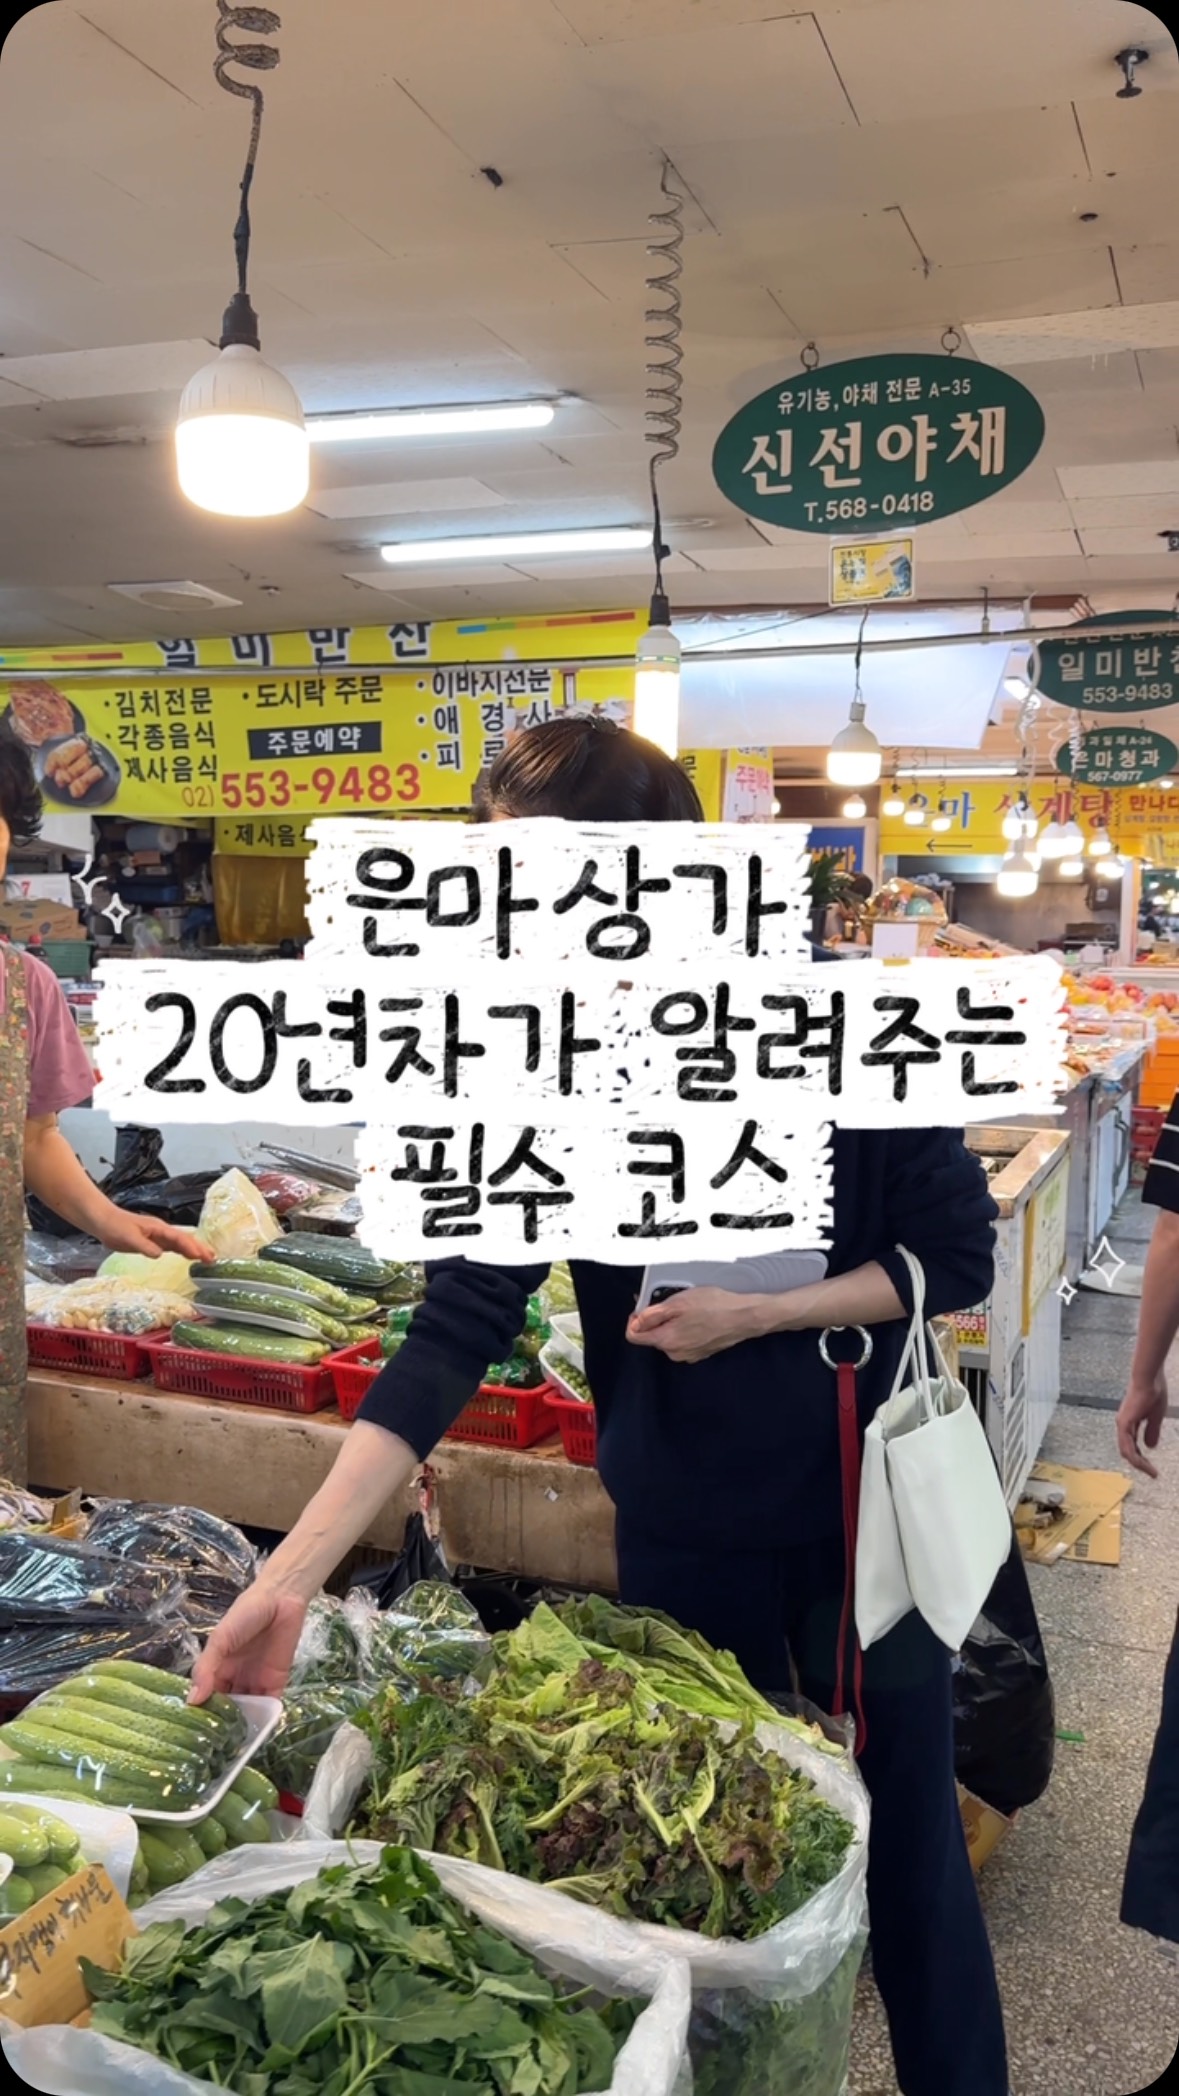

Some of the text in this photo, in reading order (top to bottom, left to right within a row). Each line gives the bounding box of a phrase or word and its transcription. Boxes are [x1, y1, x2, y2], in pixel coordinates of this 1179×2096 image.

[886, 377, 922, 404] 전문
[929, 379, 971, 399] A-35
[742, 406, 1006, 496] 신선야채
[804, 491, 934, 524] T.568-0418
[115, 686, 213, 718] 김치전문
[256, 674, 383, 709] 도시락 주문
[1082, 682, 1173, 704] 553-9483
[117, 721, 216, 752] 각종음식
[267, 726, 362, 756] 주문예약
[124, 754, 219, 784] 제사음식
[994, 788, 1113, 829] 계탕
